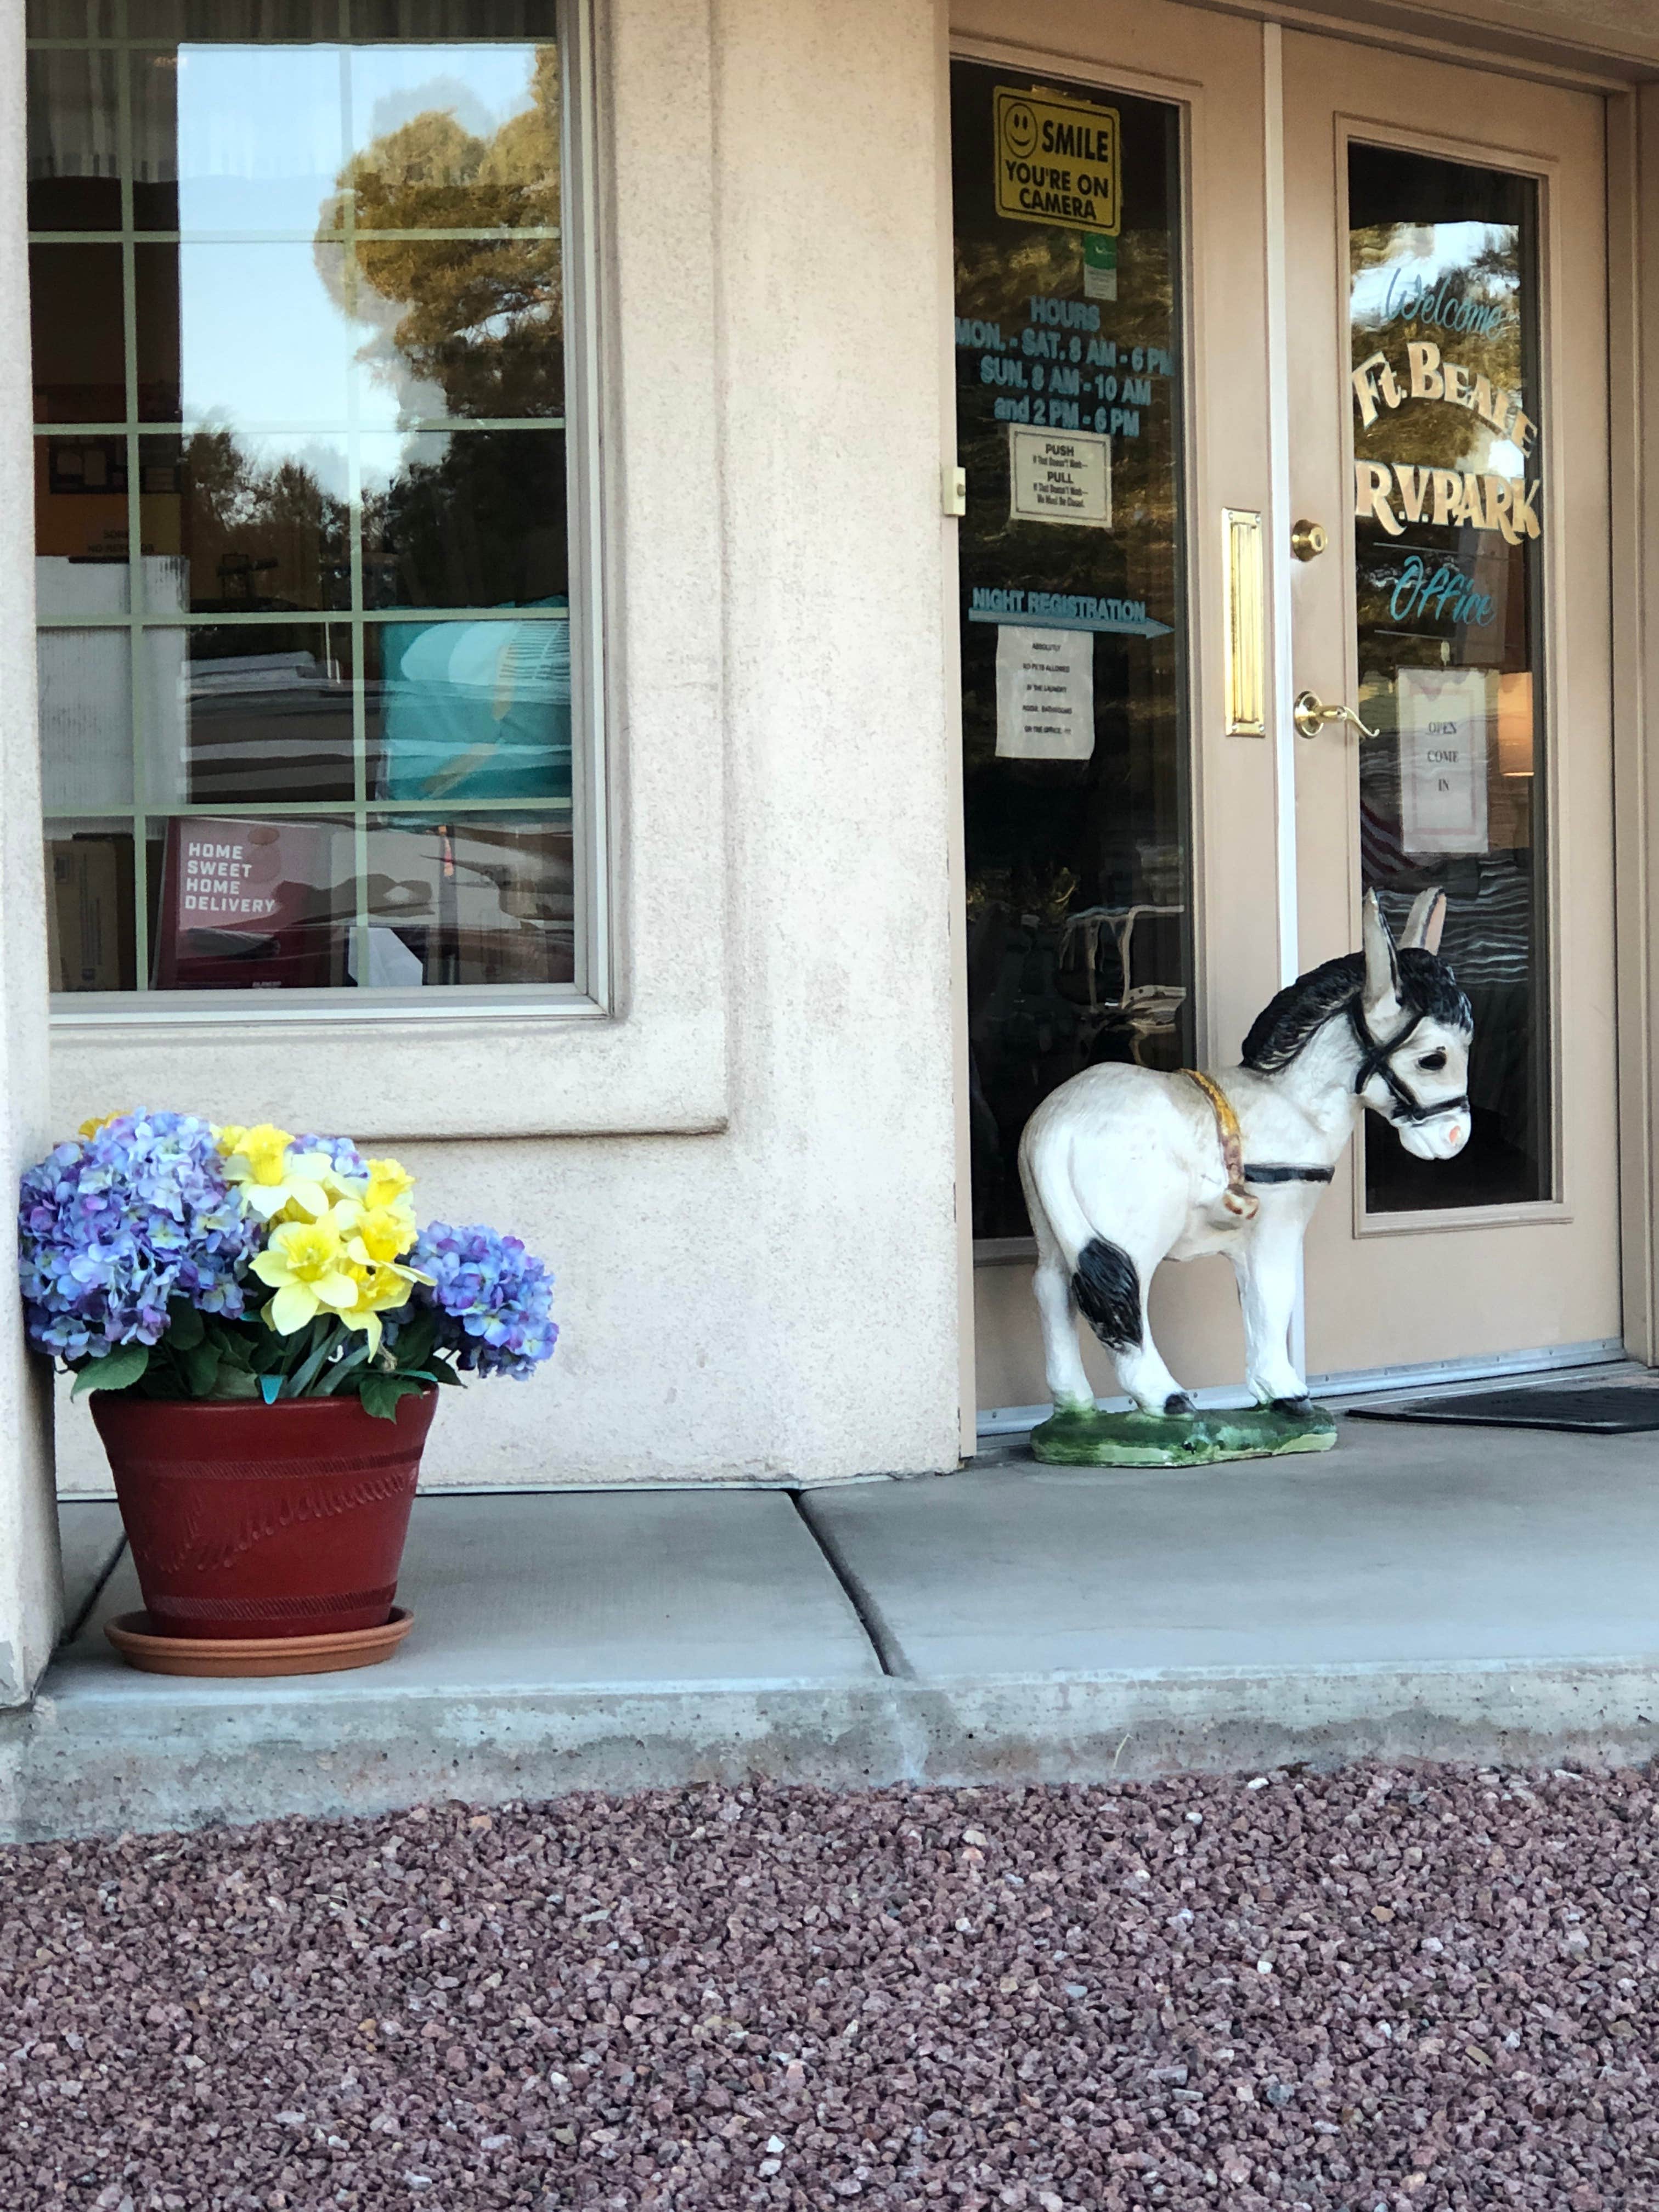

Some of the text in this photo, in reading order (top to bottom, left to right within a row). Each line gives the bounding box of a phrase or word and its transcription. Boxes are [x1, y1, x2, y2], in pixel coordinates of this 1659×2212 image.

[1042, 120, 1108, 163] SMILE
[1005, 160, 1109, 198] YOU'RE ON
[1019, 188, 1097, 219] CAMERA
[1031, 295, 1101, 332] HOURS
[1385, 267, 1505, 341] Welcome
[1022, 328, 1066, 360] SAT.
[1069, 336, 1081, 363] 8
[1086, 338, 1116, 368] AM
[1131, 346, 1143, 373] 6
[1147, 347, 1175, 376] PM
[980, 355, 1028, 388] SUN.
[1032, 364, 1044, 391] 8
[1048, 366, 1080, 396] AM
[1095, 374, 1118, 402] 10
[1122, 377, 1151, 406] AM
[994, 395, 1029, 423] and
[1033, 398, 1046, 425] 2
[1049, 399, 1079, 430] PM
[1094, 407, 1107, 433] 6
[1110, 408, 1139, 438] PM
[1352, 341, 1537, 458] Ft. BEALE
[1045, 443, 1074, 456] PUSH
[1047, 471, 1074, 484] PULL
[1432, 469, 1541, 546] PARK
[973, 587, 1146, 624] NIGHT REGISTRATION
[1390, 555, 1496, 627] Office
[1428, 720, 1457, 735] OPEN
[1427, 749, 1459, 764] COME
[1437, 779, 1449, 792] IN
[187, 860, 252, 878] SWEET
[188, 842, 243, 859] HOME
[185, 895, 275, 912] DELIVERY
[186, 877, 240, 895] HOME
